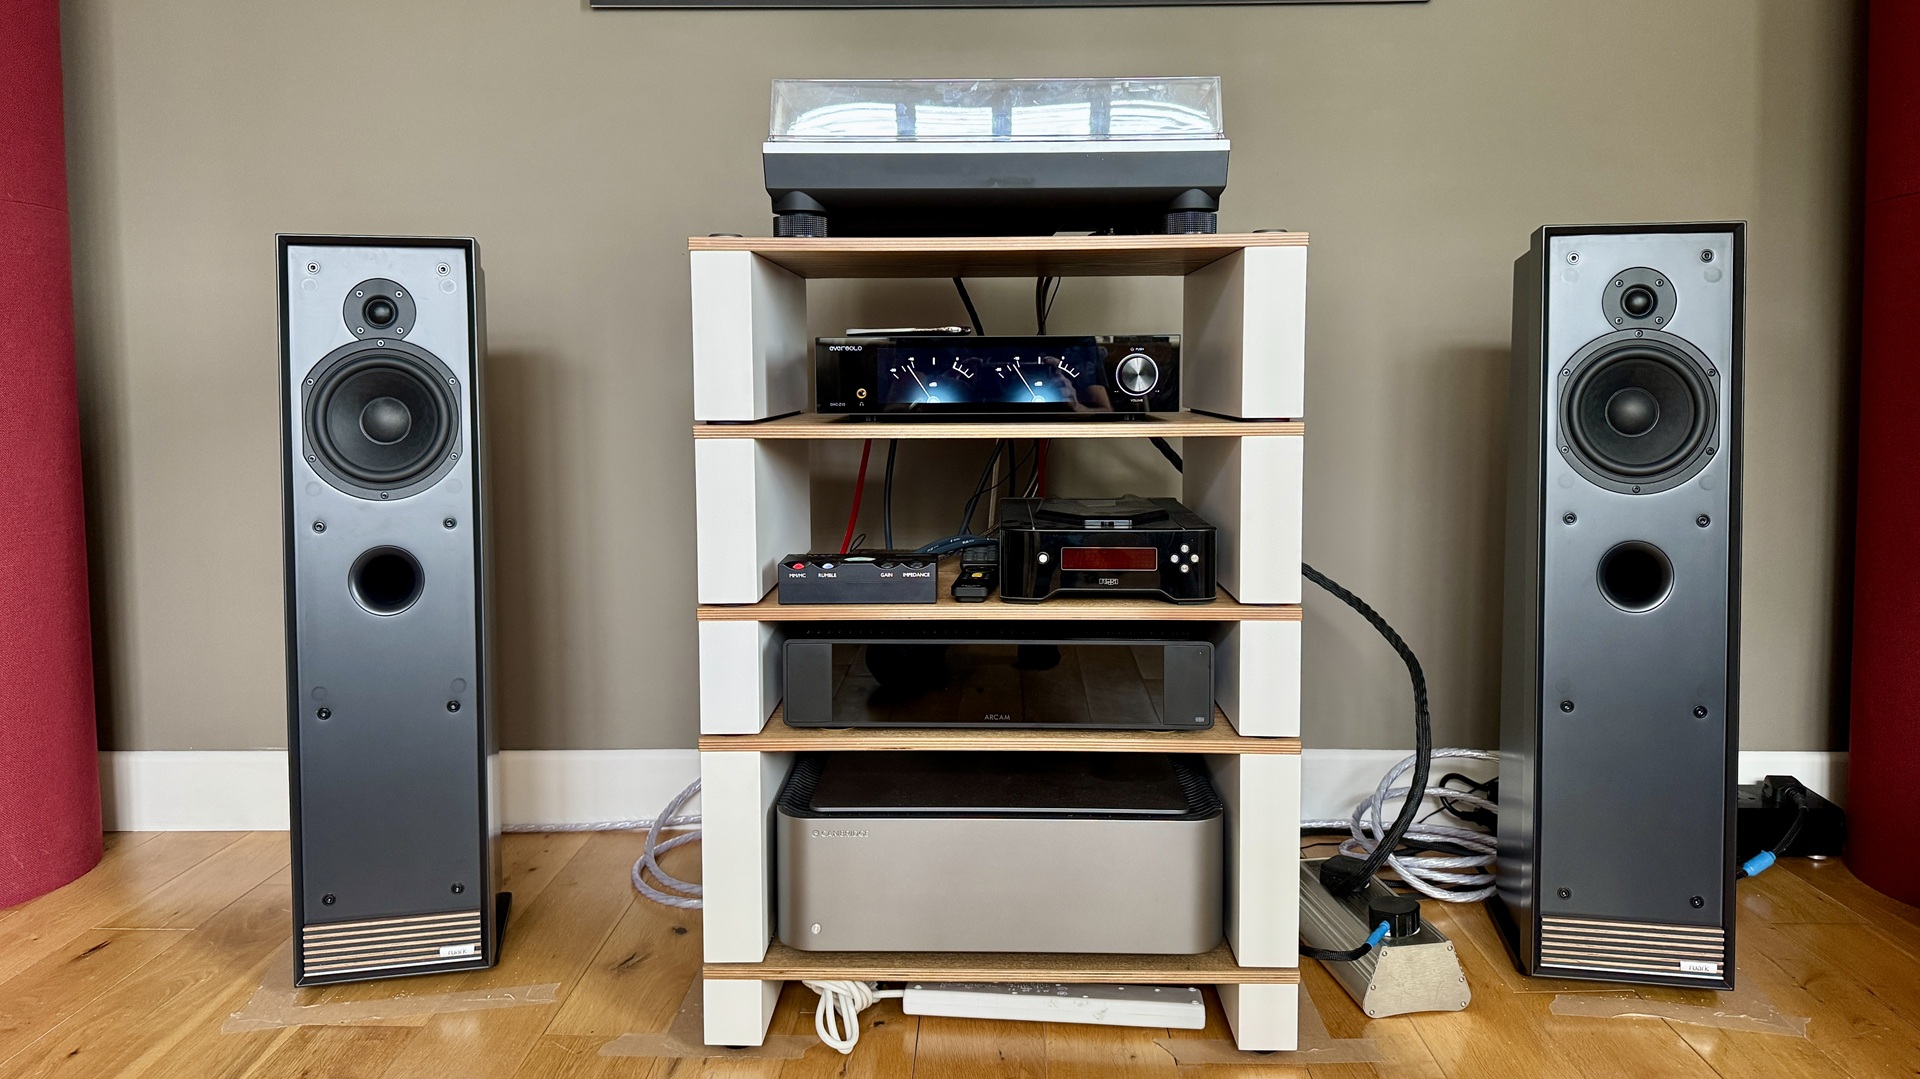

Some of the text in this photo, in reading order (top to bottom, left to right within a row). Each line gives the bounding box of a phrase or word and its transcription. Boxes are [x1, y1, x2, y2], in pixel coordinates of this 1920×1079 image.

[984, 713, 1011, 721] ARCAM
[821, 829, 870, 838] CAMBRIDGE
[1688, 964, 1710, 972] ruark
